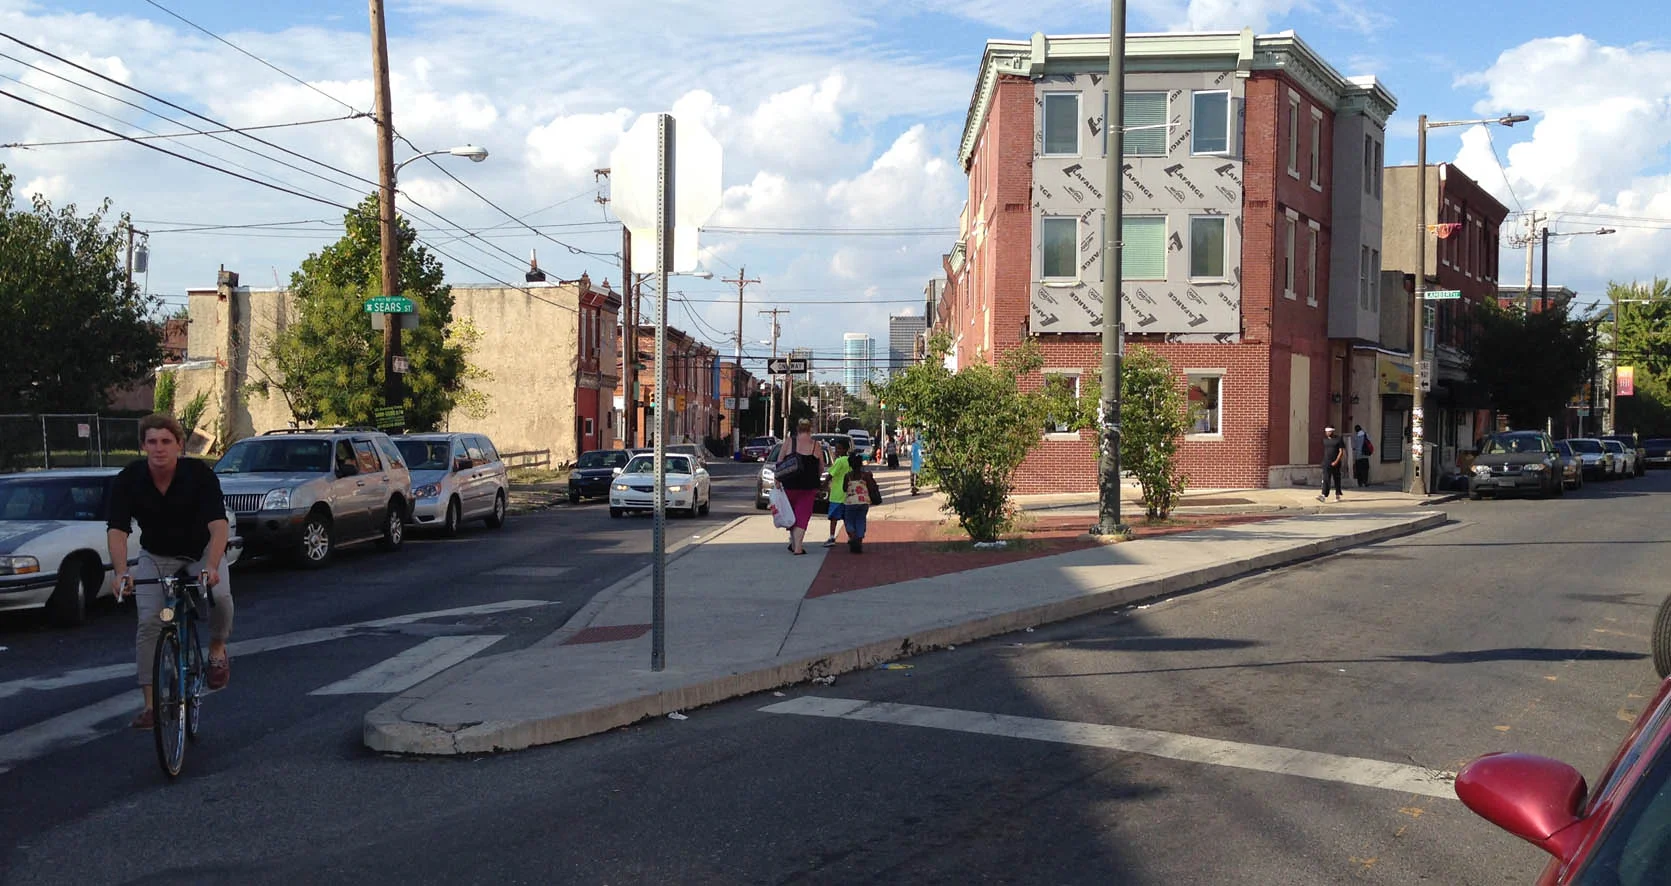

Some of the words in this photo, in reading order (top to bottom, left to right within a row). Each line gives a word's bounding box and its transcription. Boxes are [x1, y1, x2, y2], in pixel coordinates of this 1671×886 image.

[1073, 168, 1102, 200] LAFARGE
[1123, 168, 1154, 200] LAFARGE
[1174, 168, 1205, 199] LAFARGE
[374, 302, 401, 312] SEARS
[1069, 291, 1100, 321] LAFARGE
[1168, 291, 1198, 321] LAFARGE
